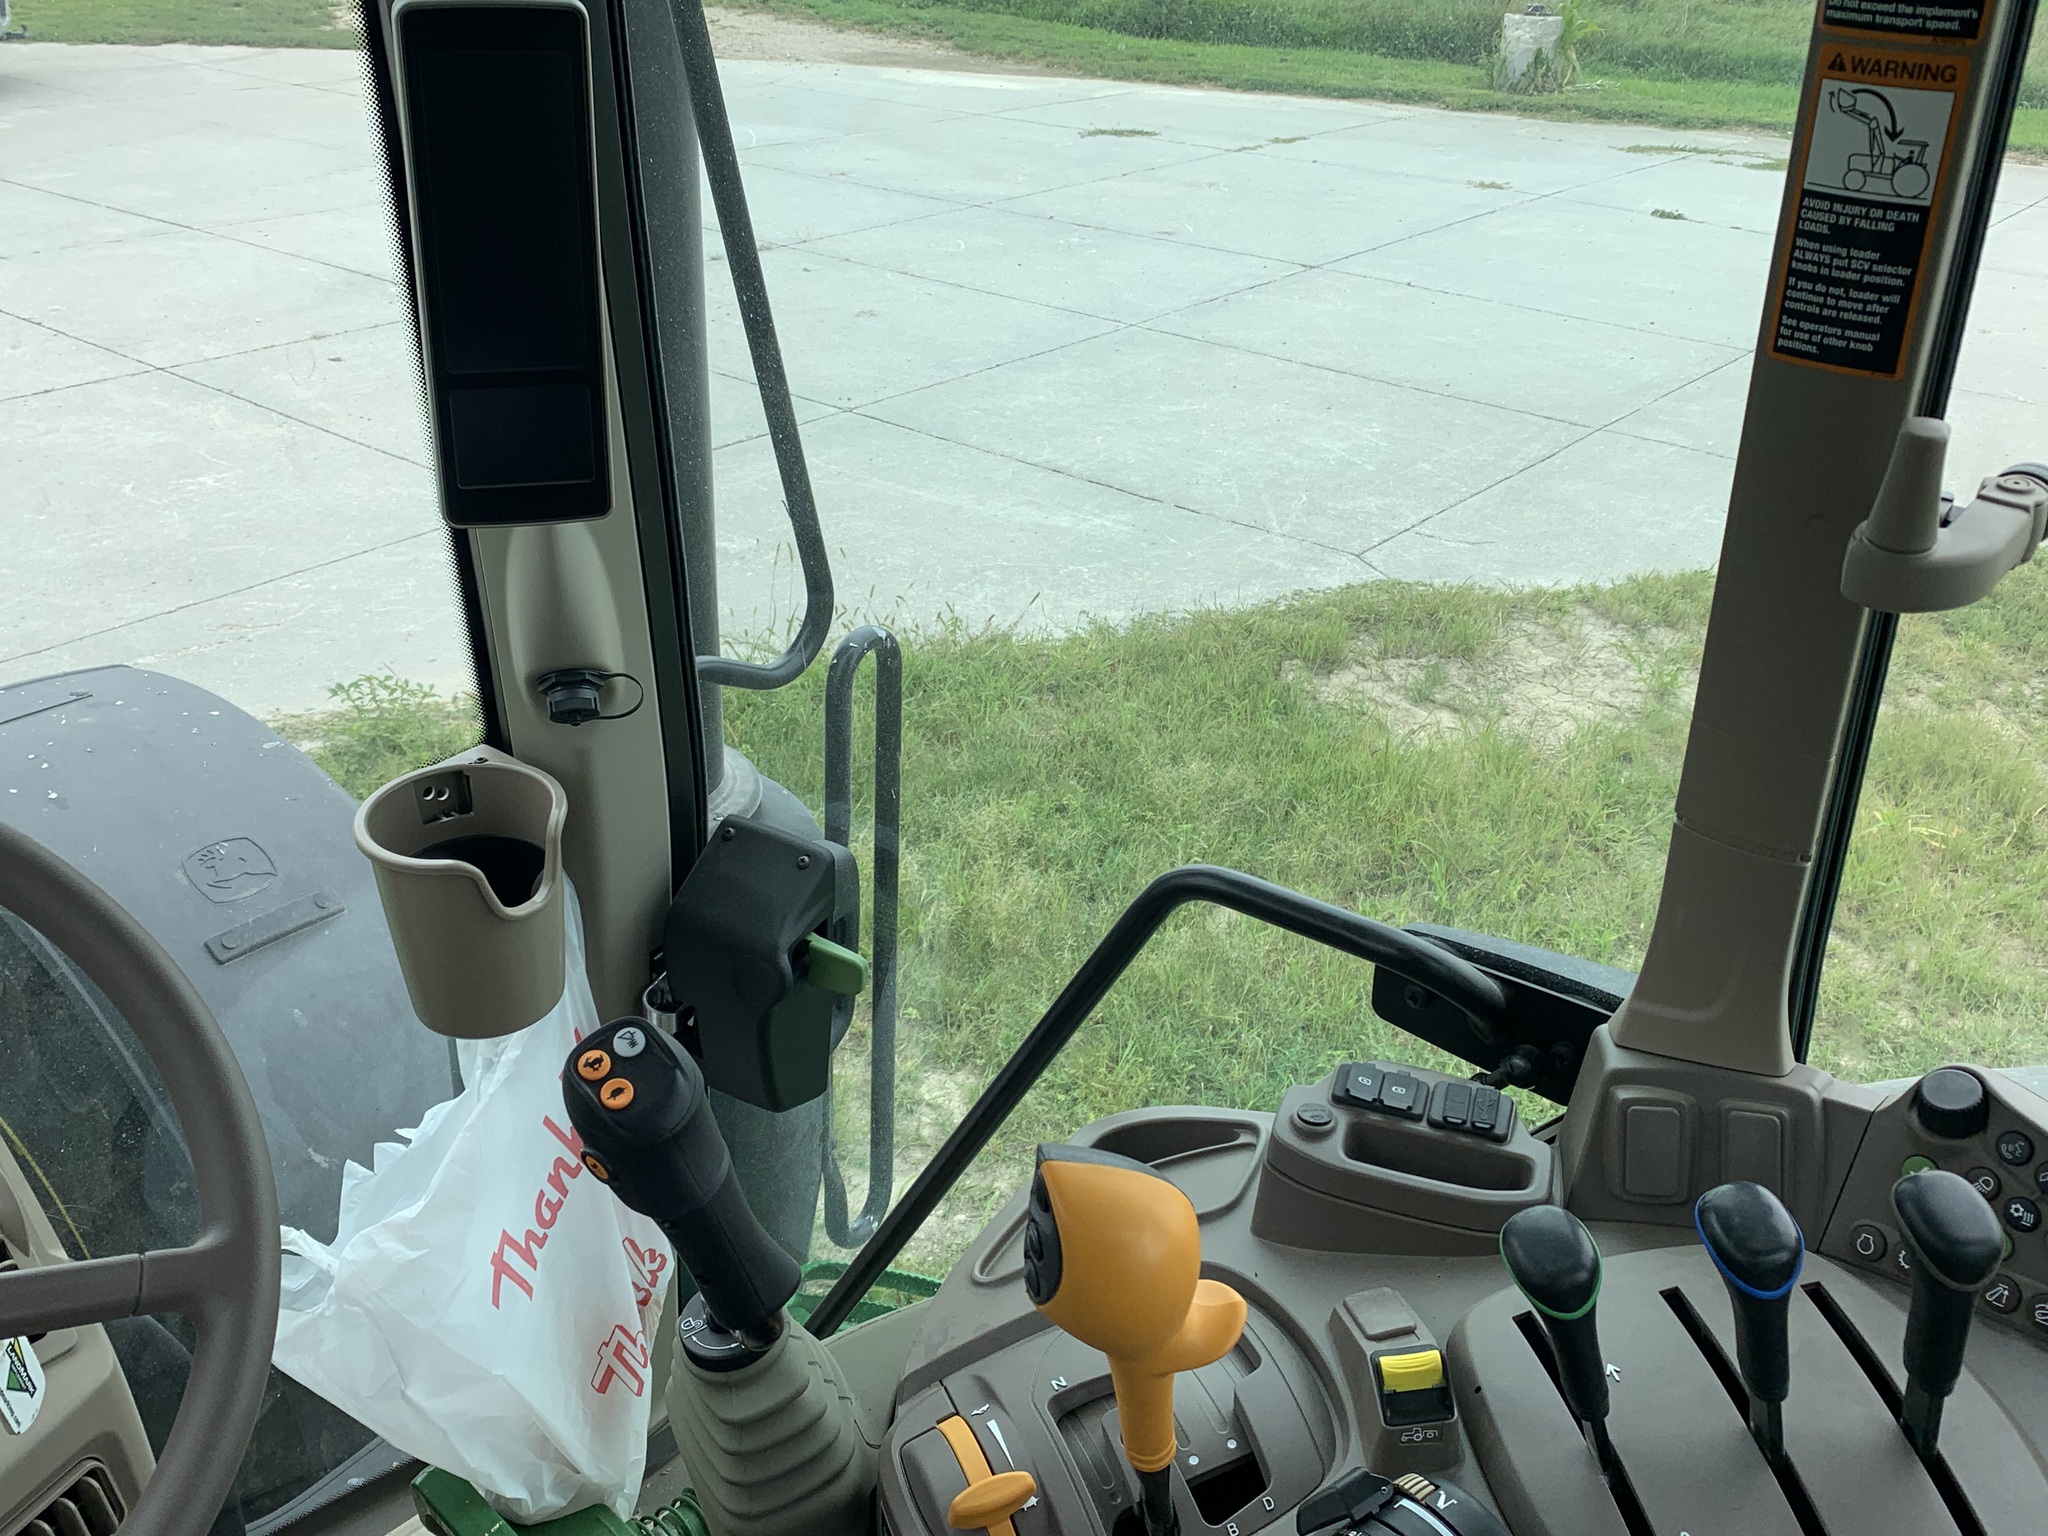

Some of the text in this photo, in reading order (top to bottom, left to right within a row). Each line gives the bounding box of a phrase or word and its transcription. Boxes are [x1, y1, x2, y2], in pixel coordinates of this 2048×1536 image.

[1826, 9, 1961, 31] maximum transport speed.
[1843, 0, 1859, 8] not
[1861, 1, 1896, 13] exceed
[1898, 3, 1914, 14] the
[1916, 4, 1978, 19] implement's
[1851, 55, 1957, 83] WARNING
[1801, 208, 1895, 232] CAUSED BY FALLING
[1802, 197, 1920, 223] AVOID INJURY OR DEATH
[1798, 220, 1830, 235] LOADS.
[1796, 237, 1881, 260] When using loader
[1791, 259, 1905, 287] knobs in loader position.
[1793, 248, 1912, 276] ALWAYS put SCV selector
[1786, 289, 1890, 314] continue to move after
[1788, 276, 1901, 304] If you do not, loader will
[1784, 300, 1882, 325] controls are released.
[1779, 326, 1874, 353] for use of other knob
[1781, 315, 1881, 341] See operators manual
[1777, 338, 1820, 354] positions.
[6, 1345, 36, 1395] LANDMARK
[1050, 1375, 1067, 1391] N
[1262, 1496, 1275, 1511] D
[1226, 1522, 1240, 1536] B
